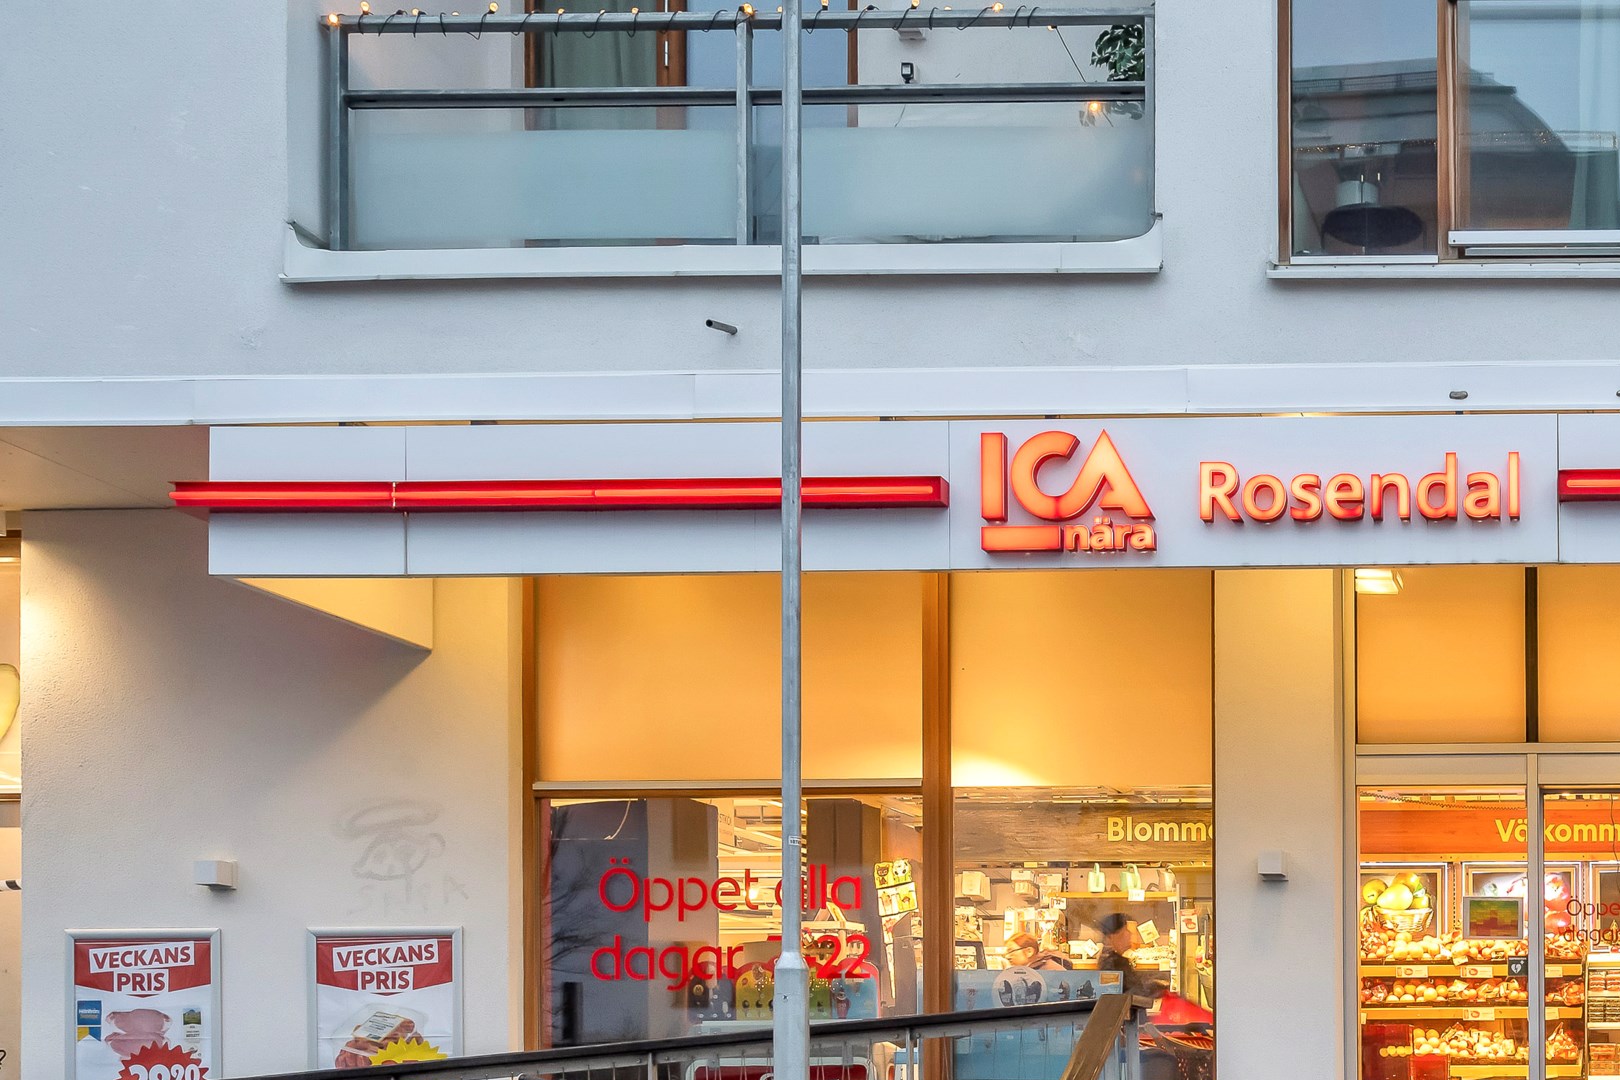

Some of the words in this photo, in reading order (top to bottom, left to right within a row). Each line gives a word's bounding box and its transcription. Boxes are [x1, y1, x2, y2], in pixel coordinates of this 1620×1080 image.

[980, 428, 1156, 522] ICA
[1199, 451, 1521, 524] Rosendal
[1063, 516, 1158, 551] nära
[1107, 816, 1213, 842] Blomm
[598, 856, 759, 922] Öppet
[1563, 925, 1620, 946] dagar
[92, 945, 191, 969] VECKANS
[336, 943, 435, 968] VECKANS
[590, 934, 744, 991] dagar
[116, 972, 166, 992] PRIS
[361, 970, 410, 990] PRIS
